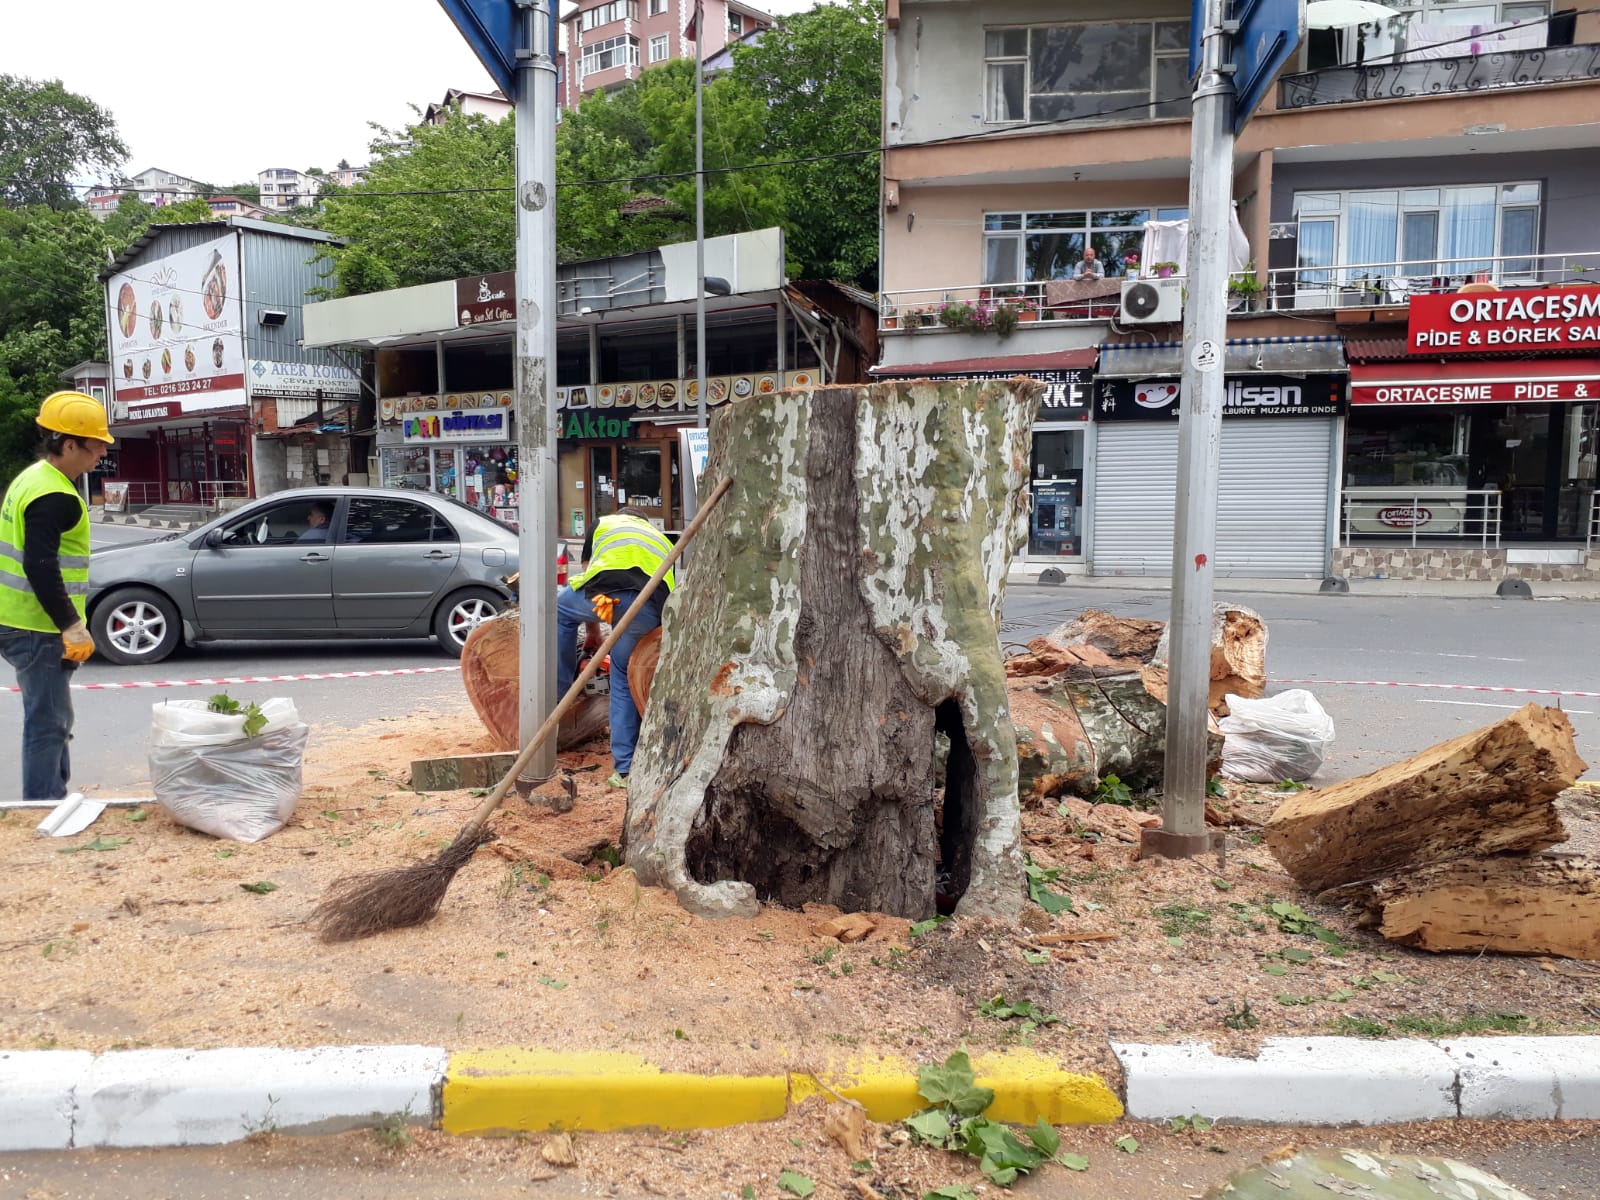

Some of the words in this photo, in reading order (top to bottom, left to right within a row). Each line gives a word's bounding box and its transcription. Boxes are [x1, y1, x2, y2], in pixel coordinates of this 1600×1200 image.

[496, 307, 513, 321] Coffee
[1416, 329, 1461, 347] PİDE
[1467, 330, 1482, 345] &
[1487, 327, 1561, 344] BÖREK
[1568, 326, 1600, 341] SA
[271, 363, 307, 377] AKER
[144, 387, 158, 396] TEL:
[160, 384, 176, 394] 0216
[177, 382, 190, 392] 323
[191, 381, 201, 390] 24
[203, 379, 212, 389] 27
[1221, 381, 1302, 407] lisan
[1376, 386, 1492, 403] ORTAÇEŞME
[1514, 382, 1559, 399] PİDE
[1574, 384, 1588, 398] &
[1260, 406, 1309, 415] MUZAFFER
[443, 411, 503, 431] DÜNYASI
[566, 412, 632, 438] Aktor
